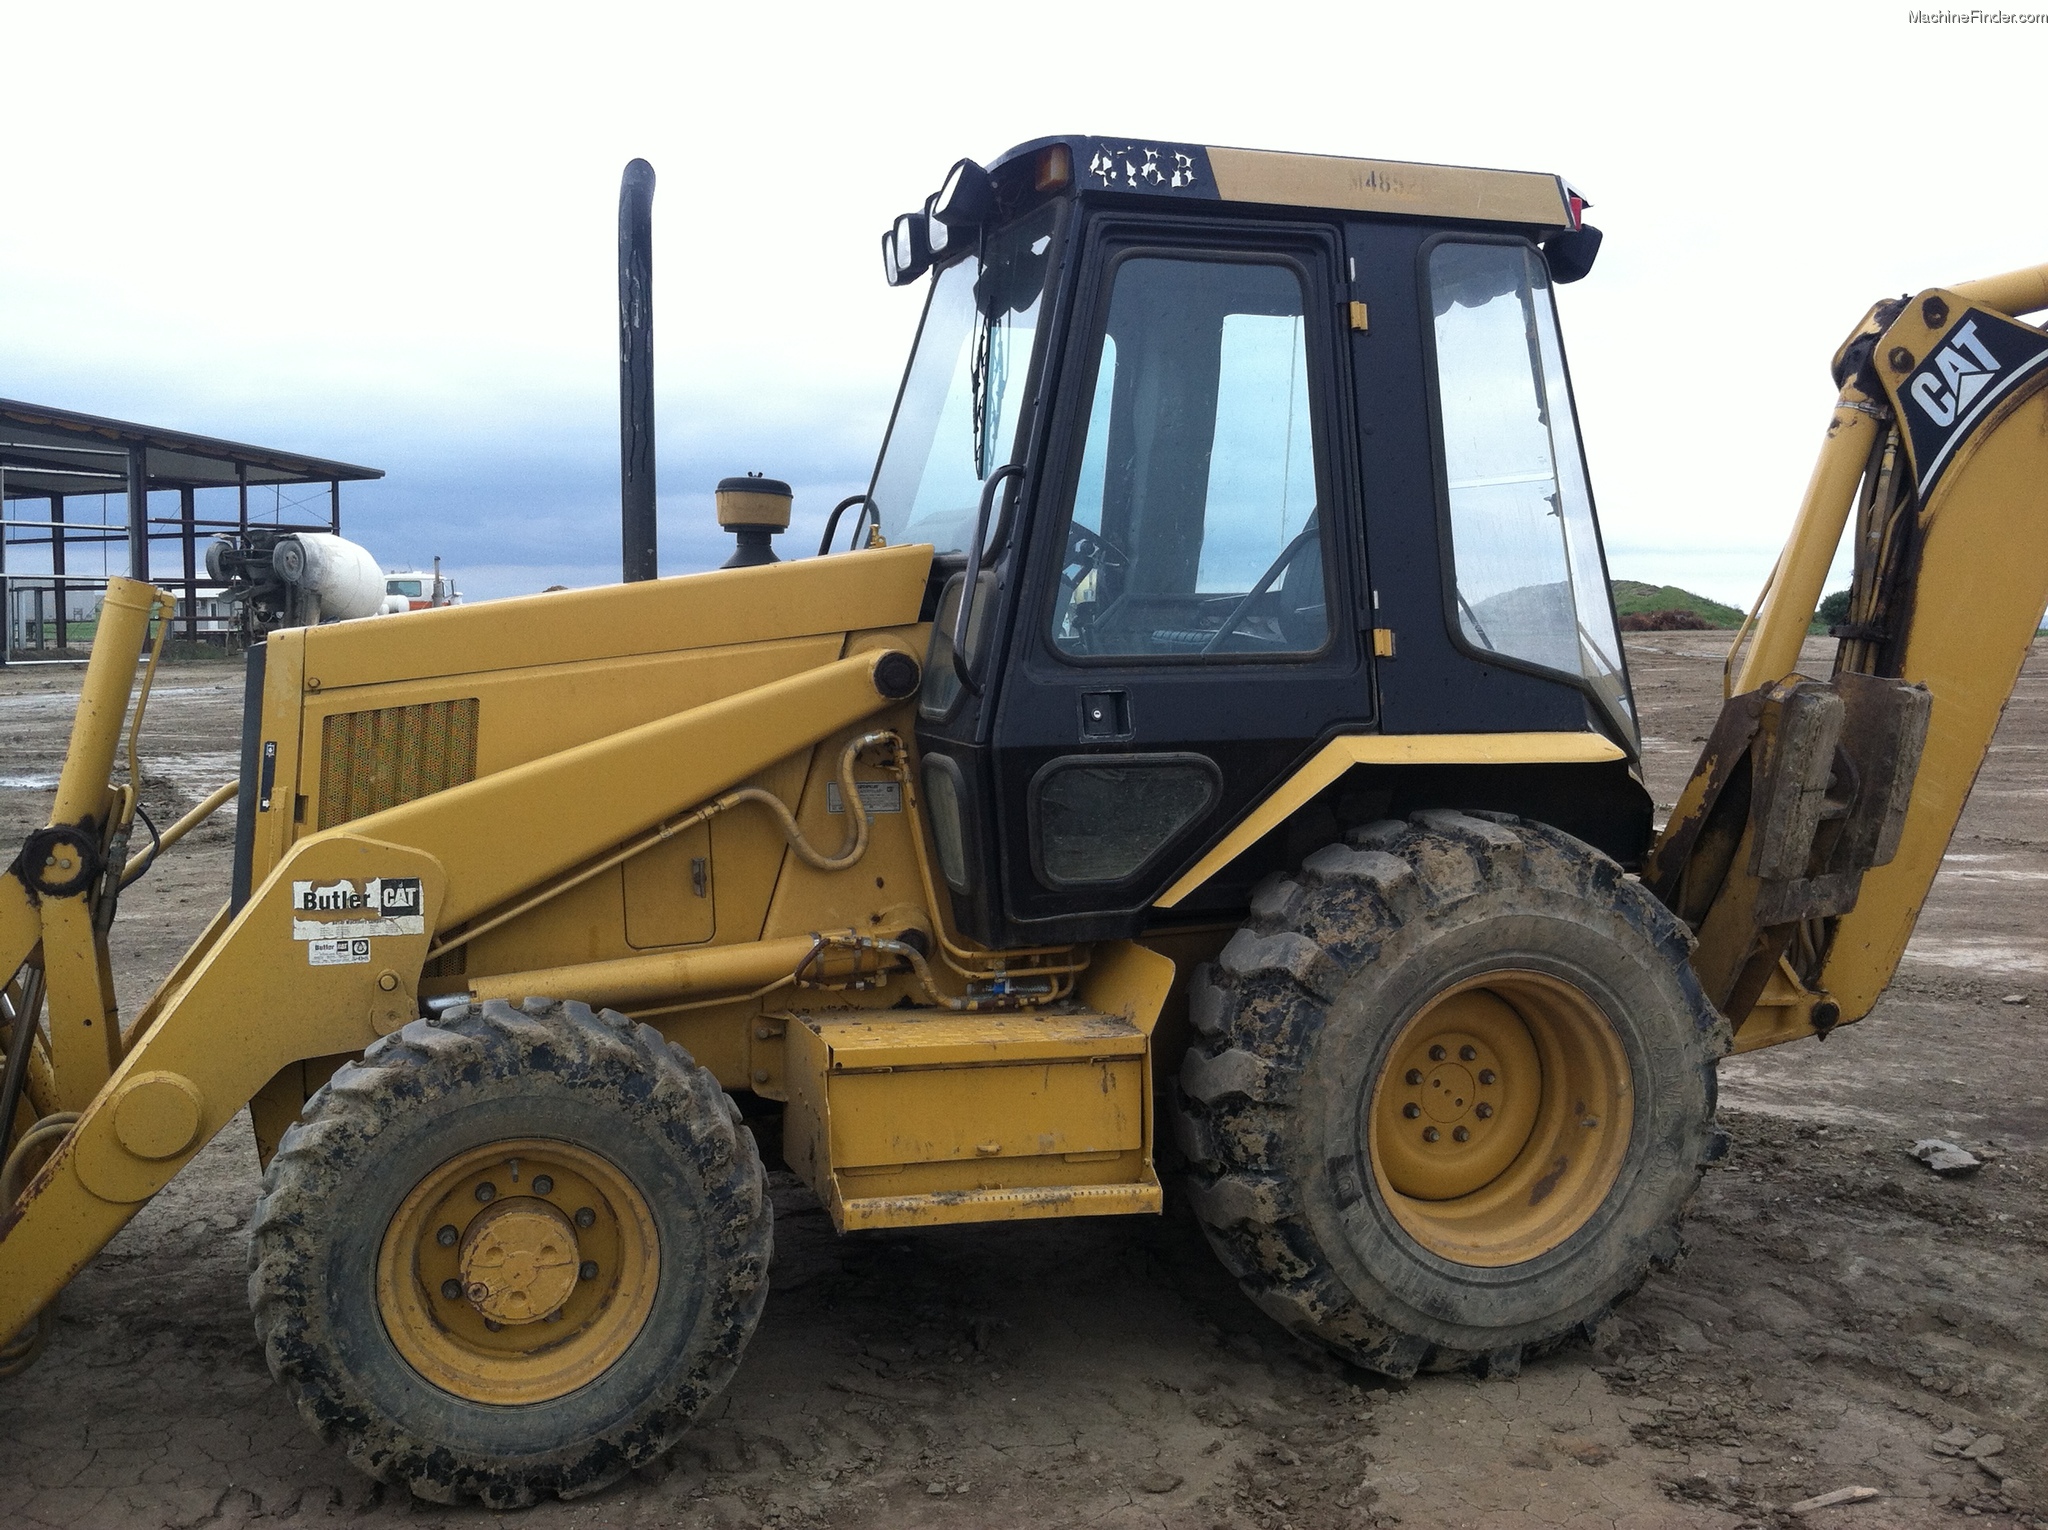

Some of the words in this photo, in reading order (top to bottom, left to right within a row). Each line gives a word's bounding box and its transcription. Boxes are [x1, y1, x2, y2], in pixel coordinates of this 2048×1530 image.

[1089, 147, 1196, 188] 416B
[1911, 319, 2001, 427] CAT
[303, 891, 370, 910] Butler
[383, 887, 416, 908] CAT
